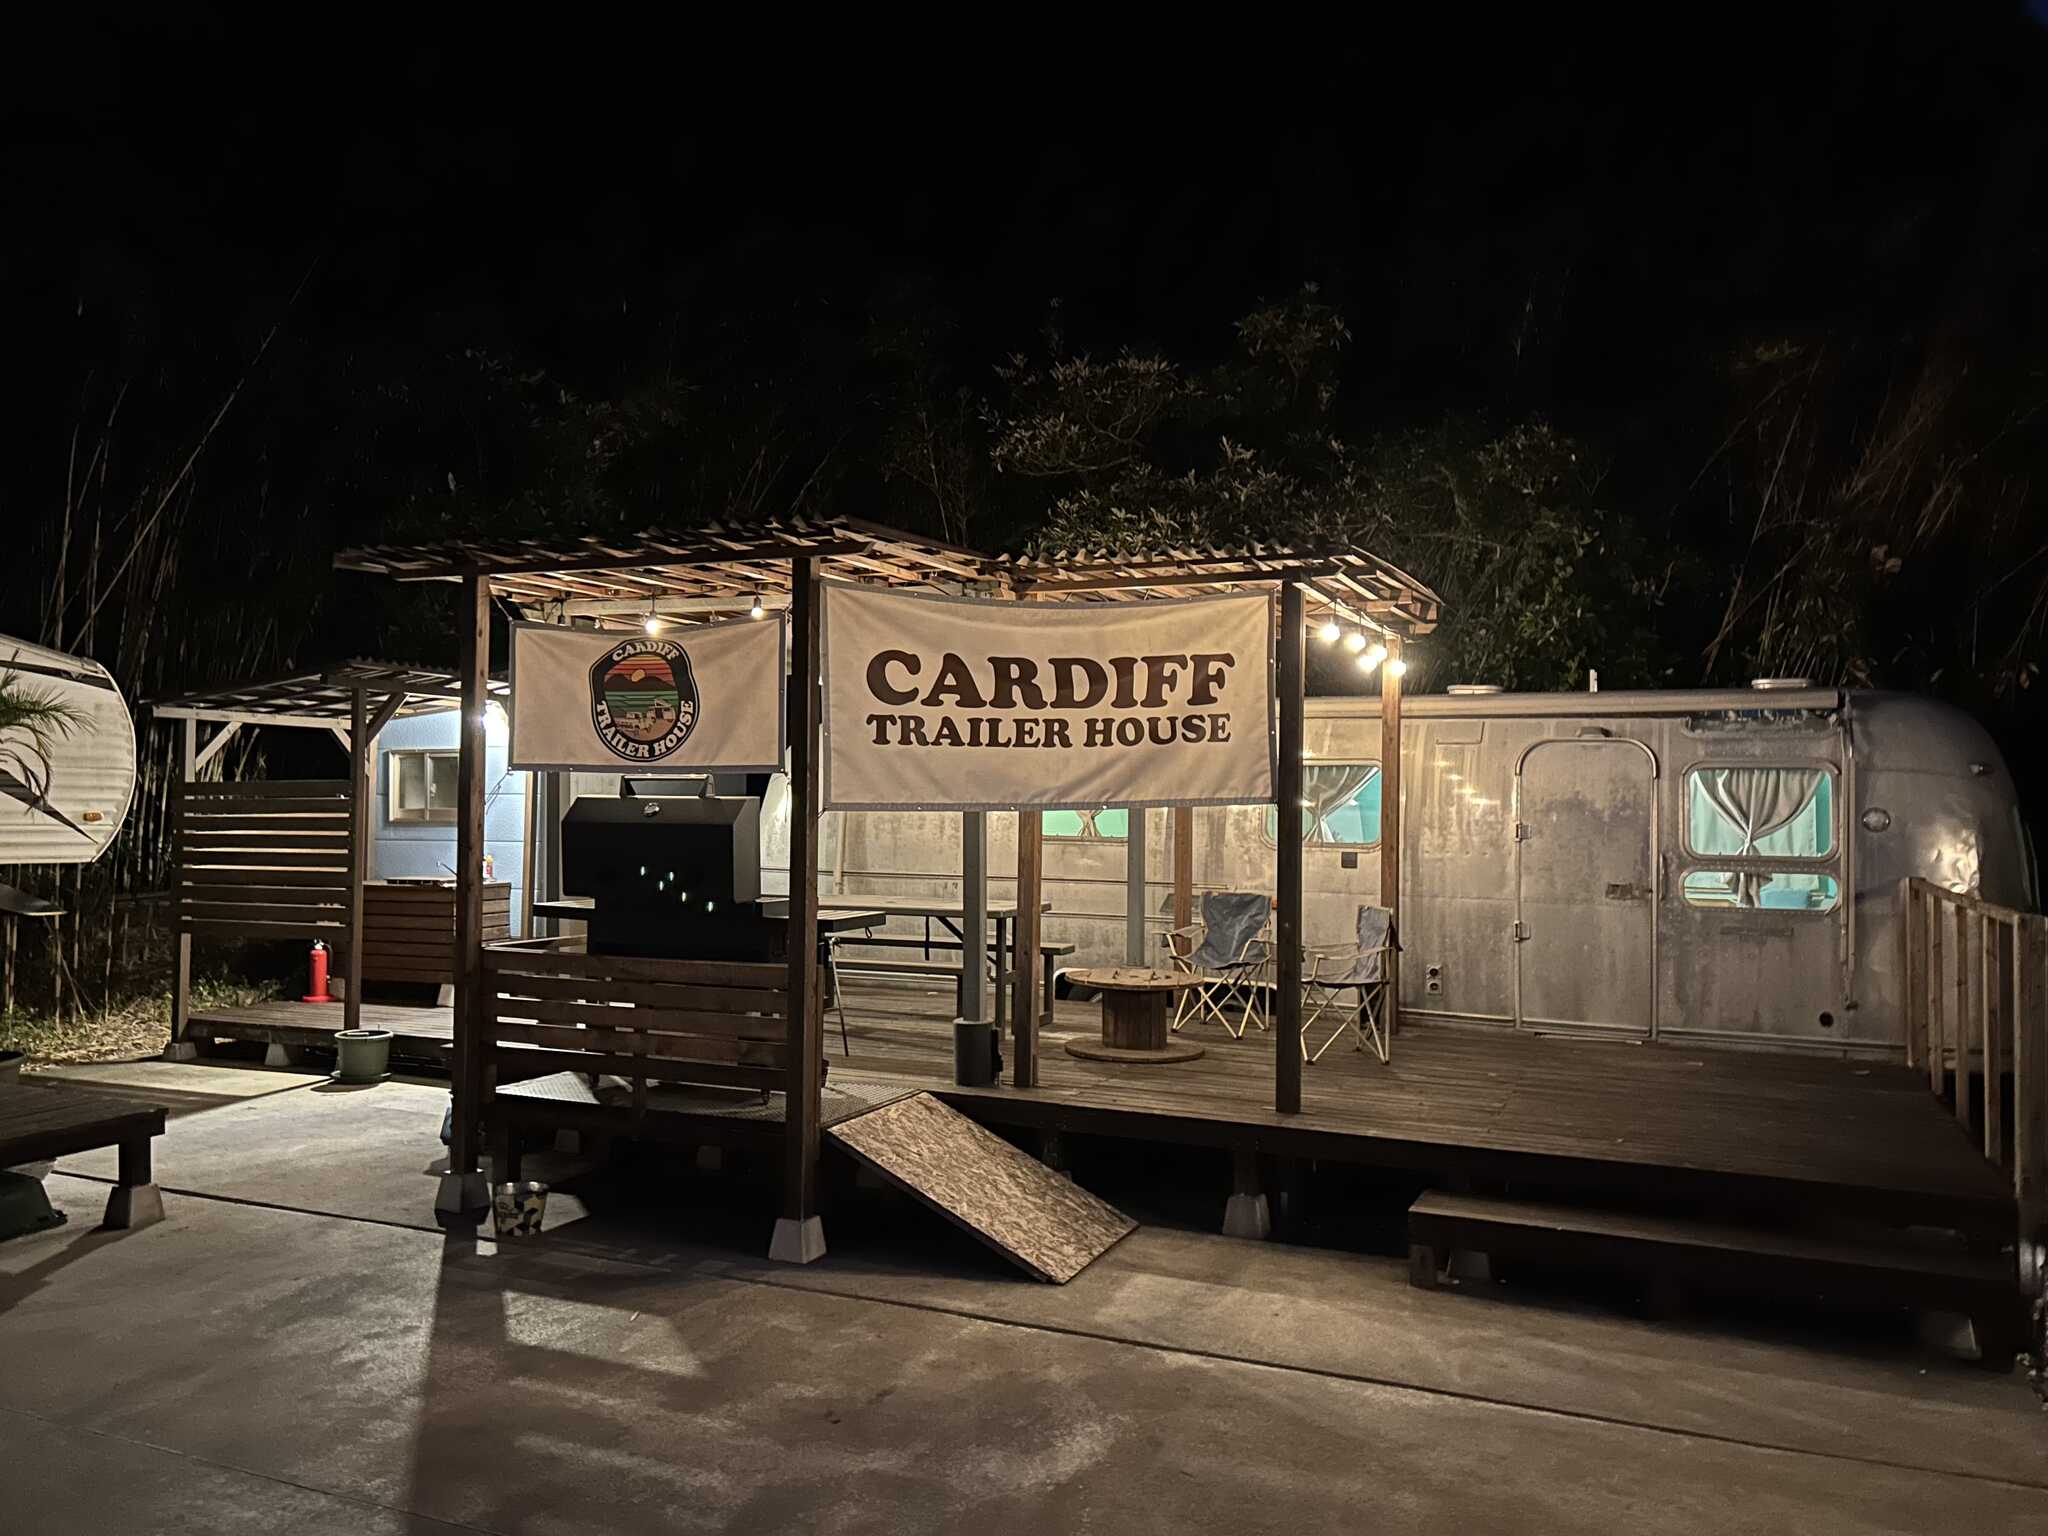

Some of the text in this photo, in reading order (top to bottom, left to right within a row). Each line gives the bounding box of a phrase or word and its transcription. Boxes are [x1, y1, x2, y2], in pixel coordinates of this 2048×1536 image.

[612, 641, 679, 661] CARDIFF
[866, 650, 1236, 709] CARDIFF
[596, 700, 693, 758] TRAILER HOUSE
[866, 713, 1231, 748] TRAILER HOUSE
